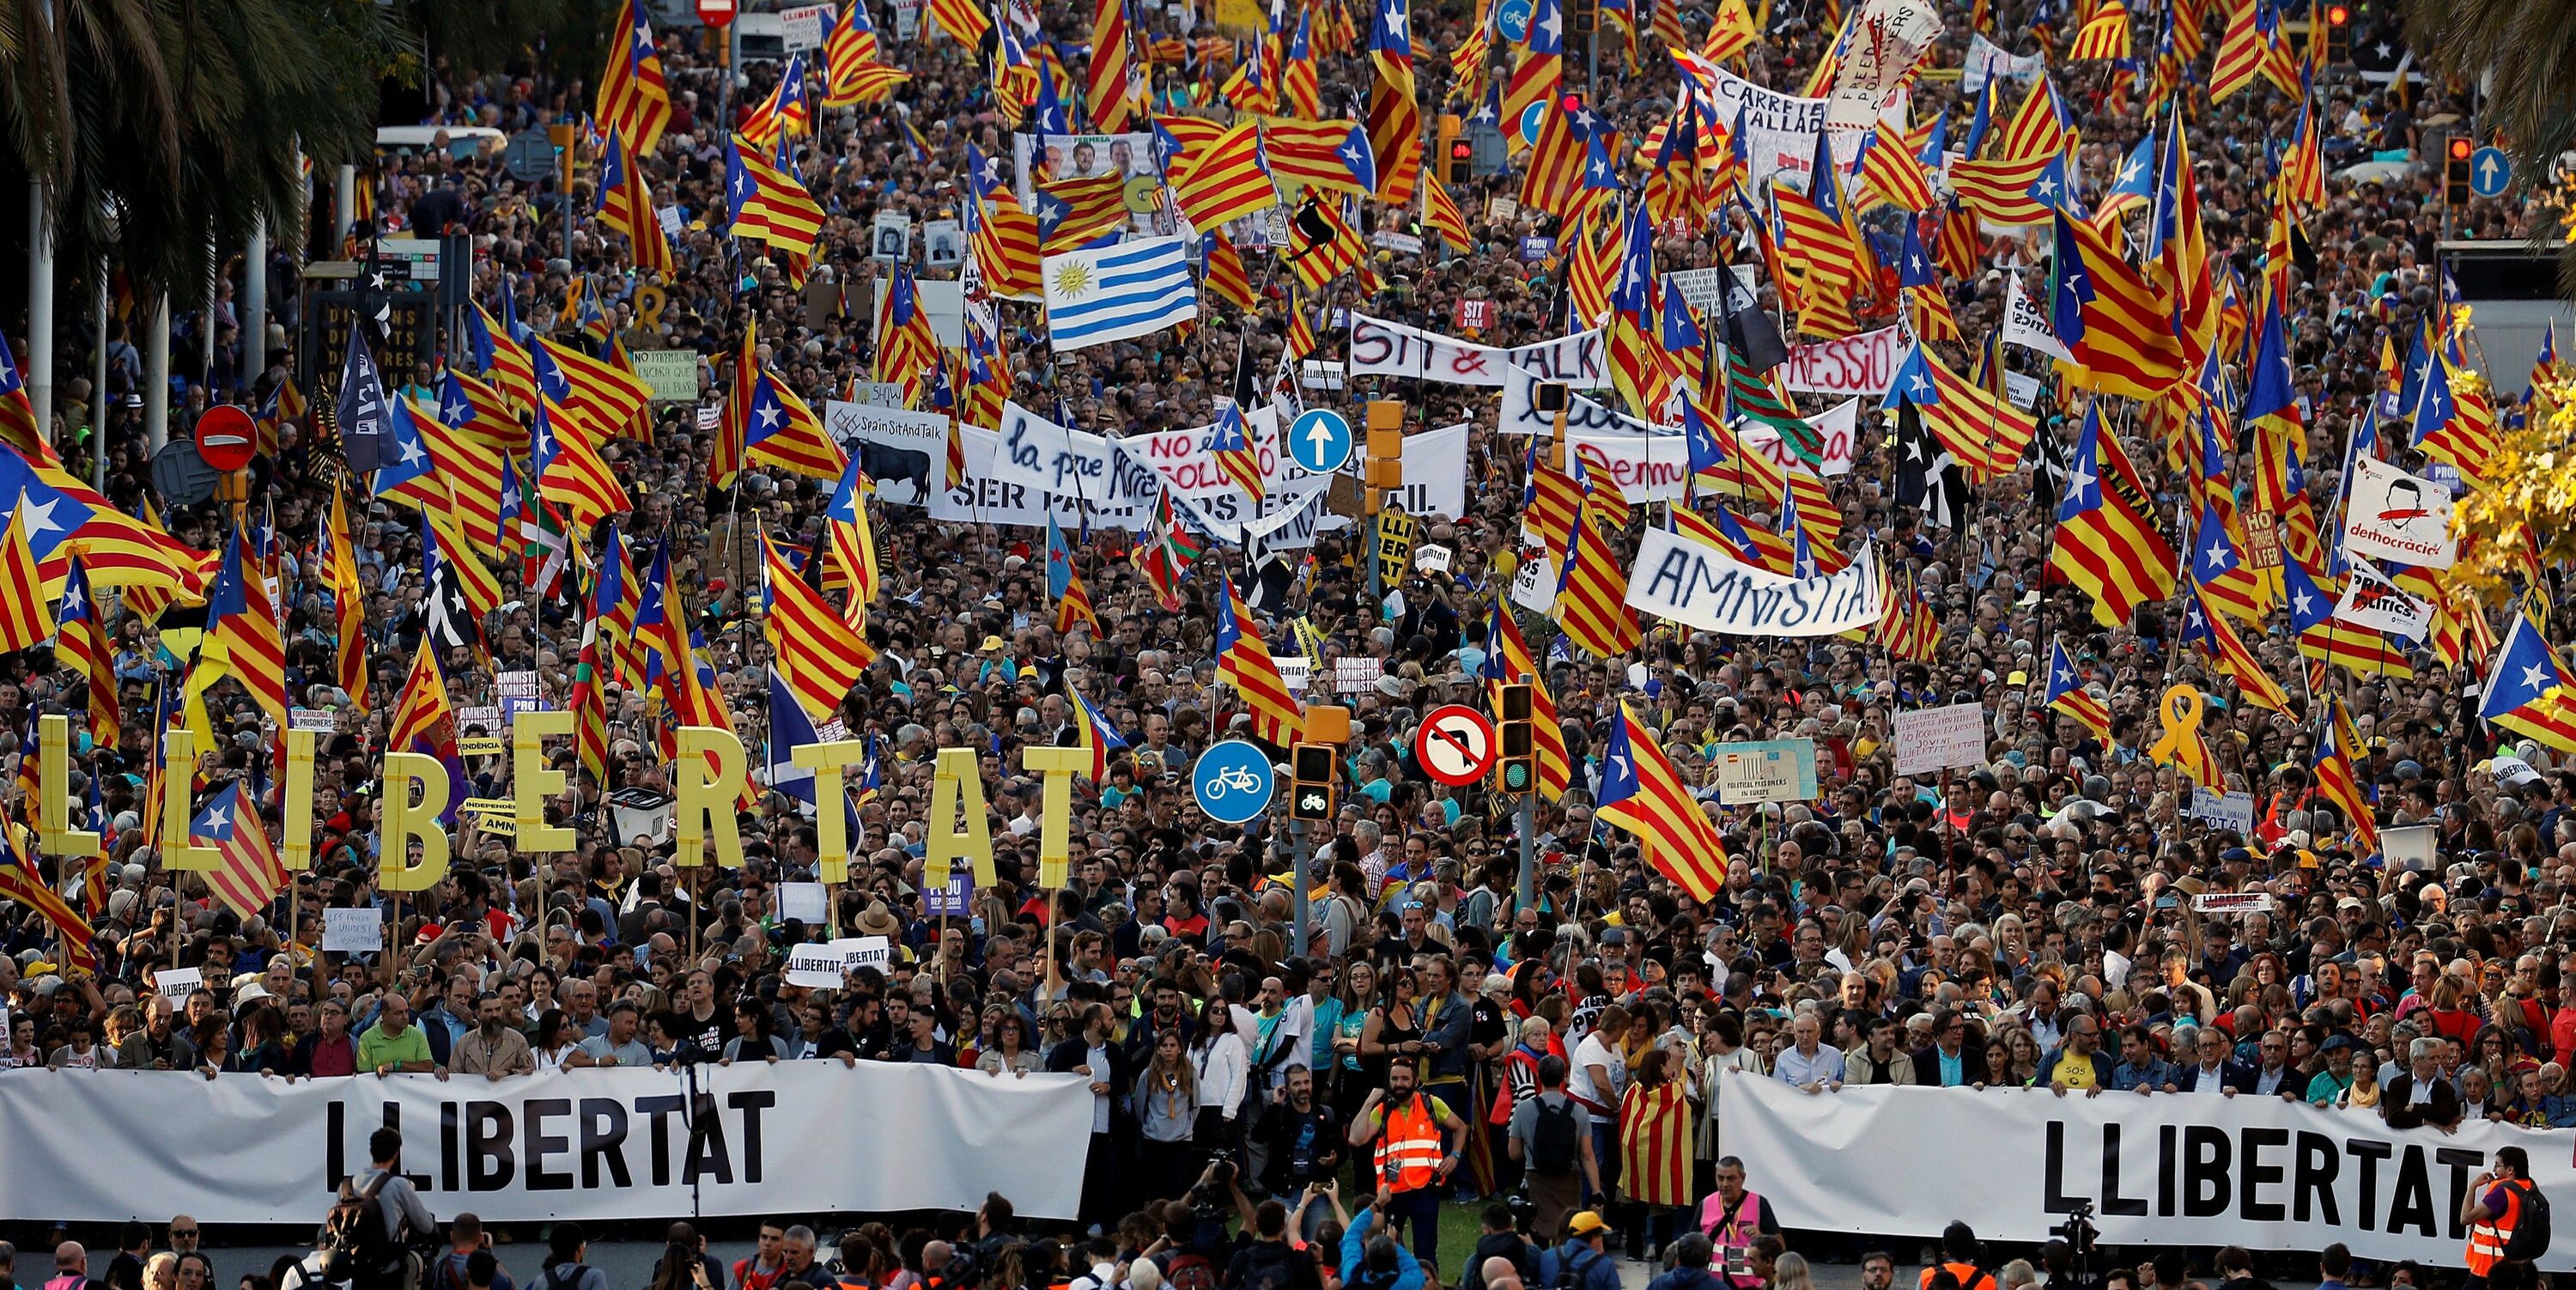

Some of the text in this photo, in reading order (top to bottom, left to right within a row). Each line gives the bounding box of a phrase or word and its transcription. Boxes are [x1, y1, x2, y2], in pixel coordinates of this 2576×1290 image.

[783, 8, 832, 21] LLIBERT
[1527, 239, 1547, 249] PROU
[329, 309, 416, 324] DINS
[1463, 301, 1485, 318] SIT
[1468, 319, 1483, 327] TALK
[1353, 320, 1434, 370] SIT
[1452, 346, 1489, 376] &
[635, 352, 649, 362] NO
[872, 386, 902, 402] SHOW
[1008, 417, 1042, 472] la
[1052, 451, 1103, 488] pre
[1151, 435, 1192, 458] NO
[951, 477, 1025, 509] SER
[1382, 516, 1413, 538] LLI
[2245, 511, 2272, 532] HO
[1417, 548, 1447, 562] LLIBERTAT
[2263, 548, 2281, 565] FER
[1379, 560, 1404, 578] AT
[1295, 618, 1316, 667] DEPENDÈNCIA
[1335, 656, 1380, 668] AMNISTIA
[1274, 666, 1306, 677] ERTAT
[1335, 668, 1380, 680] AMNISTIA
[496, 684, 542, 697] AMNISTI
[1335, 680, 1375, 693] AMNISTI
[459, 705, 501, 720] AMNISTIA
[299, 718, 333, 727] PRISONERS
[2495, 763, 2531, 782] LLIBERTAT
[1727, 778, 1787, 789] POLITICAL PRISONERS
[466, 800, 516, 809] INDEPENDÈ
[930, 896, 962, 906] REPESSIÓ
[843, 948, 885, 964] IBERTAT
[790, 956, 841, 973] LLIBERTAT
[2065, 1066, 2087, 1075] SOS
[326, 1090, 775, 1194] LLIBERTAT
[2043, 1120, 2485, 1239] LLIBERTAT
